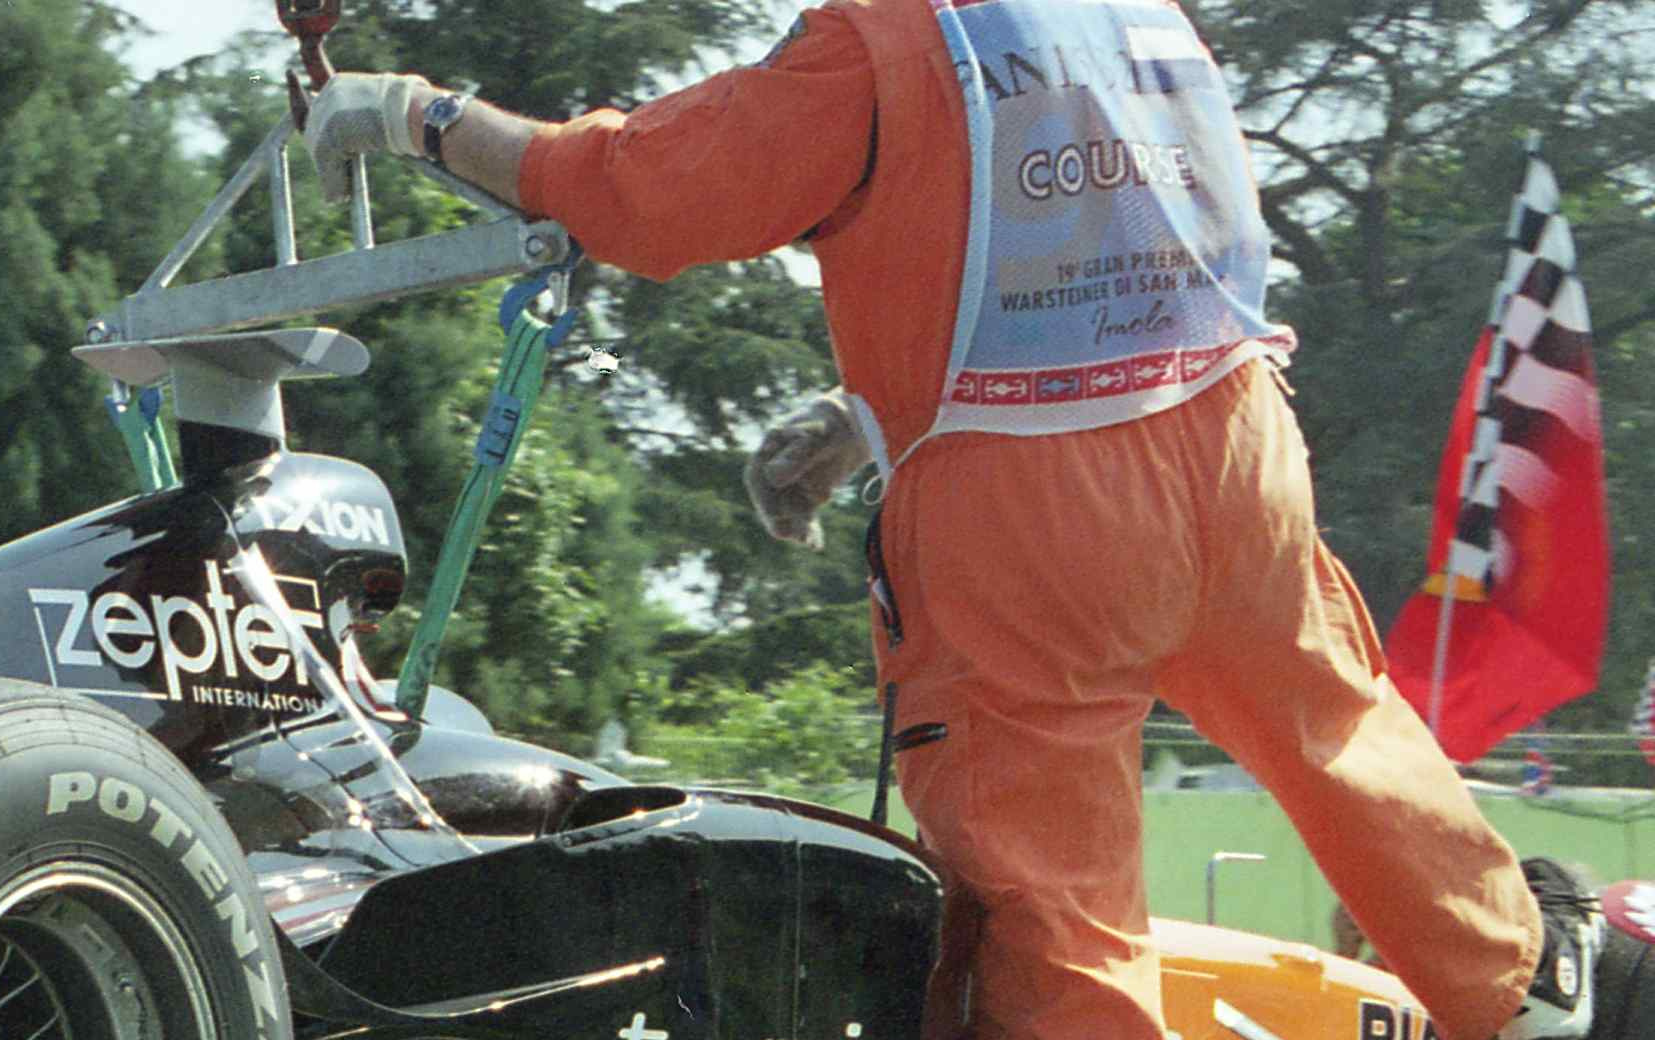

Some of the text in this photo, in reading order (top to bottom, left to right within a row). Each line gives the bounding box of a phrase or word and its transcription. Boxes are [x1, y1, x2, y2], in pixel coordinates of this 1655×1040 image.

[1019, 138, 1195, 200] COURSE
[1000, 280, 1109, 313] WARSTEINER
[1138, 271, 1177, 295] SAN
[192, 685, 328, 713] INTERNATION
